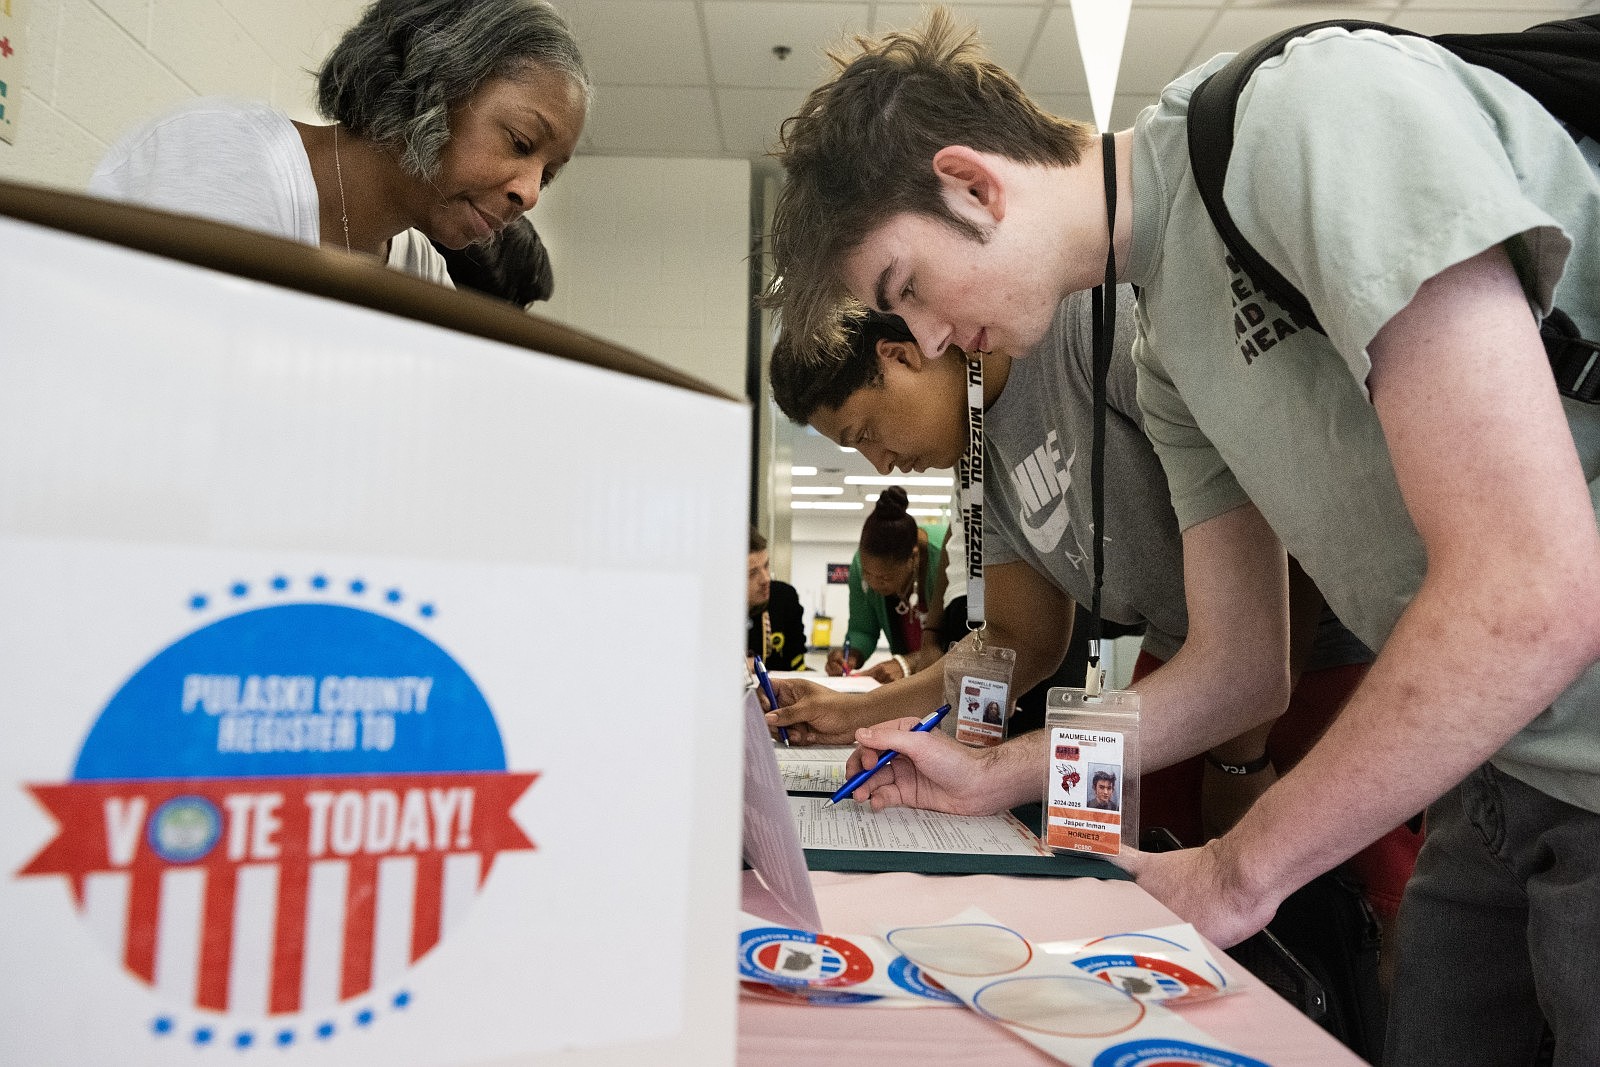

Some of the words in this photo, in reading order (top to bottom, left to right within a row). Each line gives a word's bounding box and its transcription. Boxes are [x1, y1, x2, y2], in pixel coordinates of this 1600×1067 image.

[181, 673, 315, 715] PULASKI
[318, 675, 434, 714] COUNTY
[217, 714, 357, 754] REGISTER
[361, 713, 396, 752] TO
[1059, 732, 1097, 742] MAUMELLE
[304, 787, 476, 858] TODAY!
